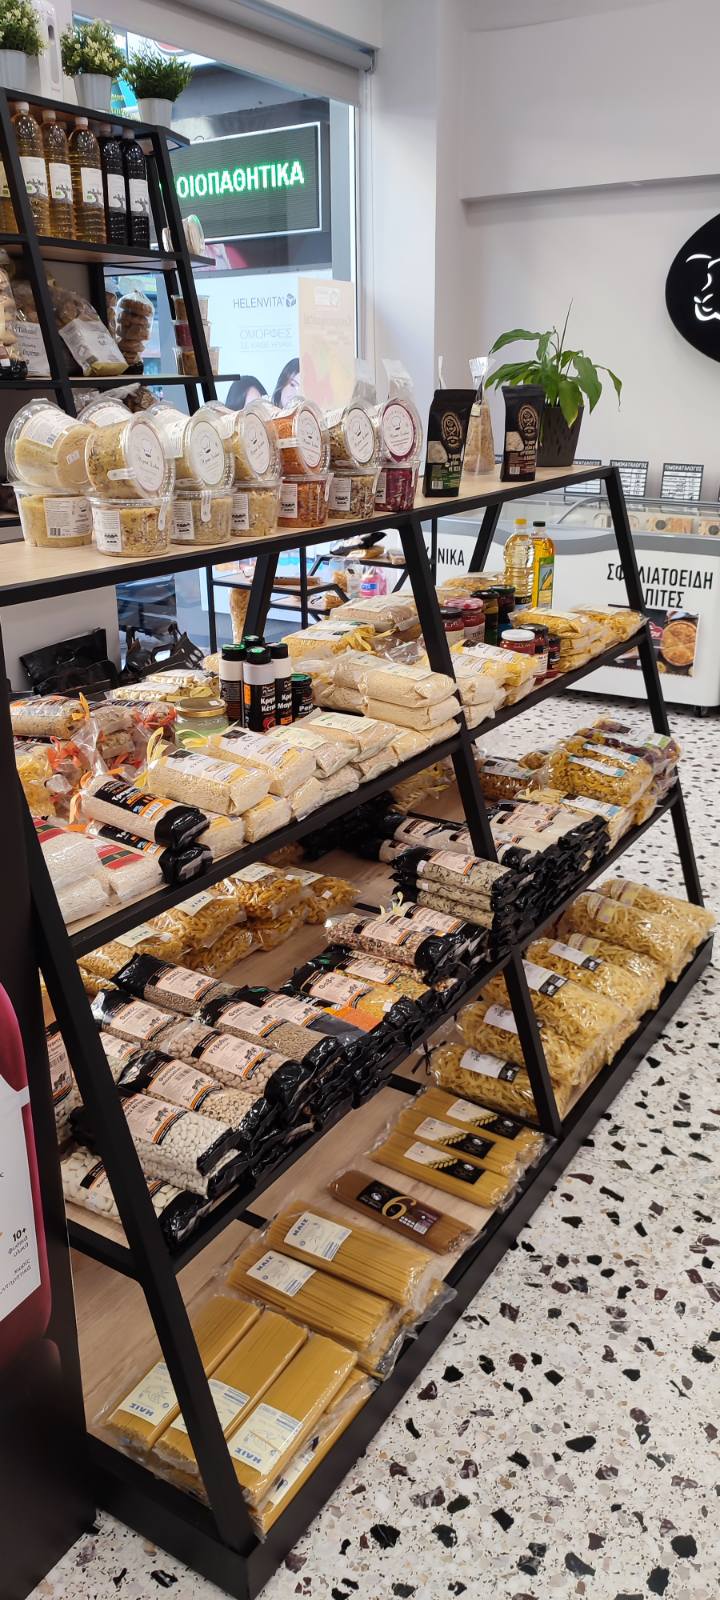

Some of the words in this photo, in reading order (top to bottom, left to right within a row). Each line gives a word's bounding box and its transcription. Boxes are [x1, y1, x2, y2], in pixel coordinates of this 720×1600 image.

[176, 160, 305, 198] ΟΙΟΠΑΘΗΤΙΚΑ
[233, 296, 283, 309] HELENVITA
[607, 563, 713, 590] ΣΦΛΙΑΤΟΕΙΔΗ
[644, 587, 685, 609] ΠΙΤΕΣ
[382, 1195, 417, 1220] 6
[13, 1227, 26, 1241] 10+
